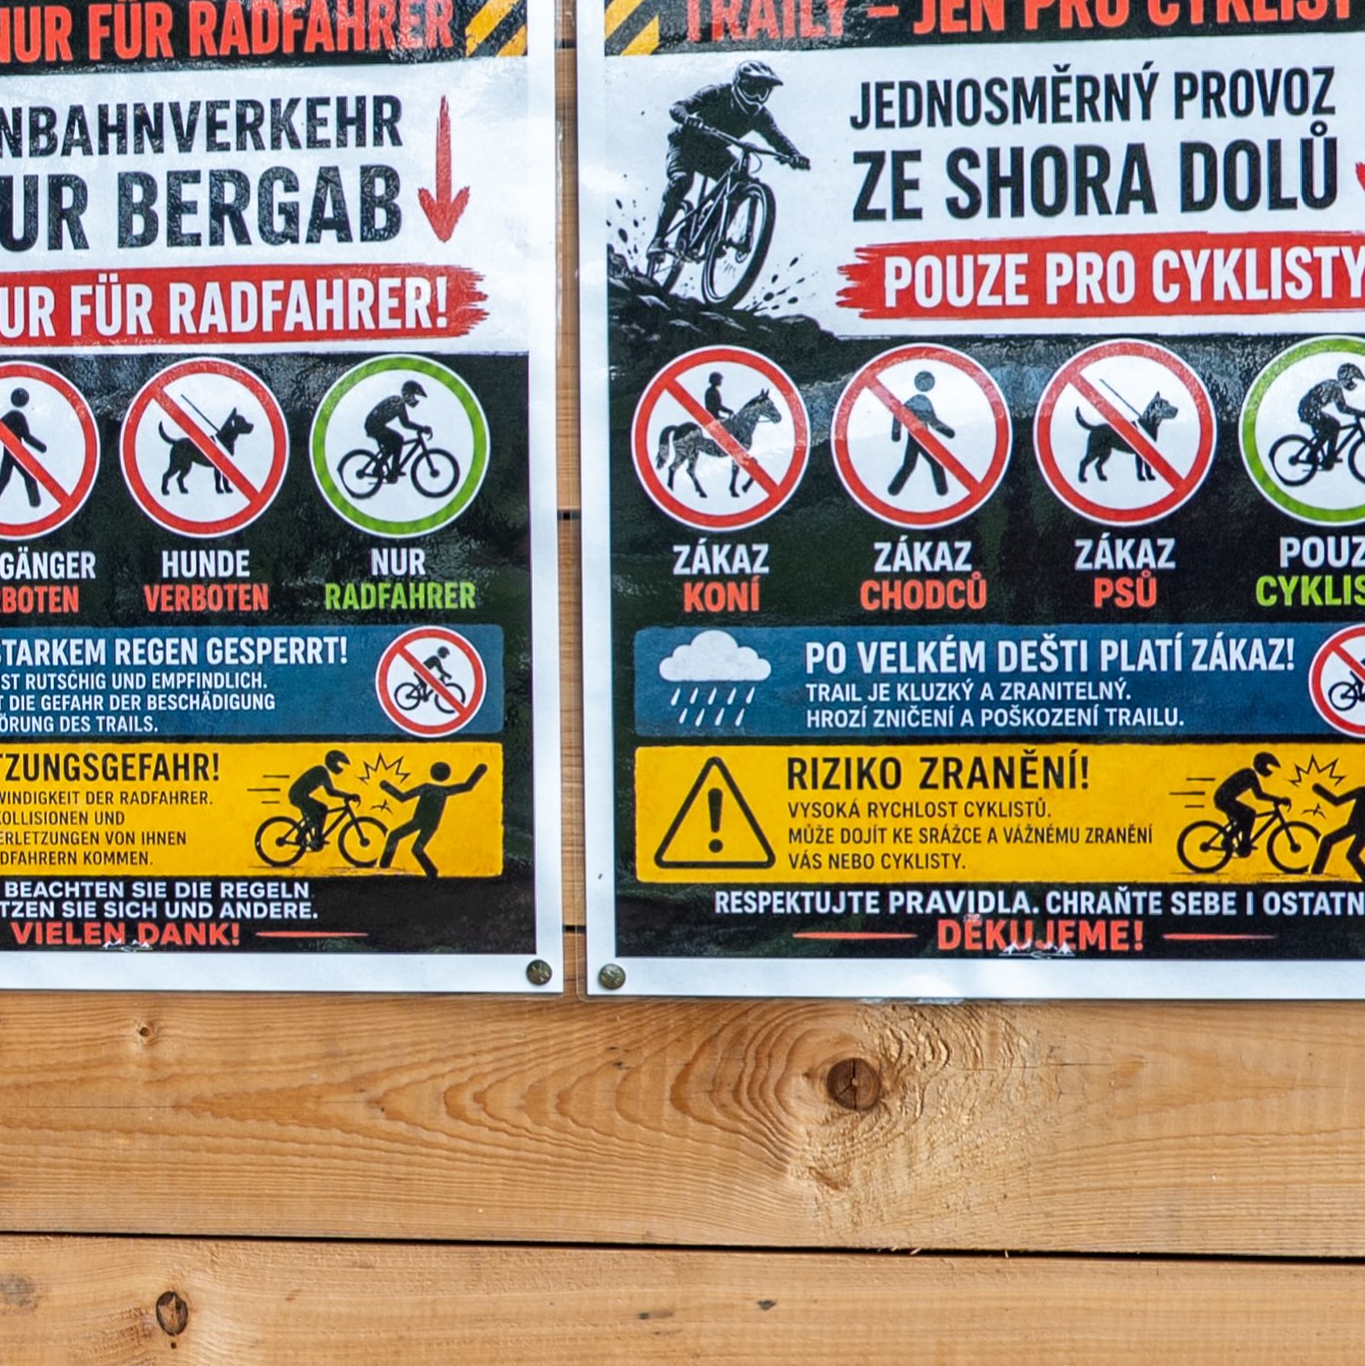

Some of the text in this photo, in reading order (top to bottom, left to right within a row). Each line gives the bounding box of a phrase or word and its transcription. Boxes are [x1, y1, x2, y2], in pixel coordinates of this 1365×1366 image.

[850, 61, 1335, 130] JEDNOSMĚRNÝ PROVOZ
[853, 121, 1337, 222] ZE SHORA DOLŮ
[117, 165, 401, 248] BERGAB
[885, 254, 1028, 307] POUZE
[1046, 251, 1135, 304] PRO
[71, 273, 153, 336] FÜR
[170, 276, 447, 333] RADFAHRER!
[162, 550, 250, 577] HUNDE
[372, 548, 425, 575] NUR
[673, 538, 769, 574] ZÁKAZ
[874, 535, 971, 572] ZÁKAZ
[1075, 533, 1175, 570] ZÁKAZ
[144, 584, 268, 611] VERBOTEN
[324, 581, 475, 610] RADFAHRER
[684, 575, 759, 612] KONÍ
[861, 571, 986, 610] CHODCŮ
[1095, 570, 1156, 608] PSŮ
[116, 638, 197, 665] REGEN
[207, 637, 347, 664] GESPERRT!
[806, 632, 1294, 673] PO VELKÉM DEŠTI PLATÍ ZÁKAZ!
[112, 673, 146, 689] UND
[152, 672, 267, 689] EMPFINDLICH.
[806, 677, 1131, 701] TRAIL JE KLUZKÝ A ZRANITELNÝ.
[10, 695, 35, 711] DIE
[41, 695, 103, 711] GEFAHR
[110, 695, 141, 710] DER
[148, 691, 275, 710] BESCHÄDIGUNG
[60, 716, 90, 732] DES
[96, 716, 158, 732] TRAILS.
[807, 704, 1184, 727] HROZÍ ZNIČENÍ A POŠKOZENÍ TRAILU.
[788, 749, 1088, 790] RIZIKO ZRANĚNÍ!
[86, 791, 113, 804] DER
[120, 791, 213, 805] RADFAHRER.
[788, 797, 1051, 818] VYSOKÁ RYCHLOST CYKLISTŮ.
[95, 811, 124, 825] UND
[105, 831, 135, 845] VON
[142, 831, 186, 845] IHNEN
[789, 824, 1152, 844] MŮŽE DOJÍT KE SRÁŽCE A VÁŽNÉMU ZRANĚNÍ
[84, 851, 153, 865] KOMMEN.
[789, 850, 965, 869] VÁS NEBO CYKLISTY.
[5, 882, 124, 897] BEACHTEN
[132, 882, 166, 898] SIE
[175, 882, 212, 898] DIE
[715, 886, 1364, 915] RESPEKTUJTE PRAVIDLA. CHRAŇTE SEBE I OSTATN
[62, 901, 96, 917] SIE
[104, 901, 157, 918] SICH
[165, 902, 213, 918] UND
[220, 902, 317, 918] ANDERE.
[11, 922, 239, 945] VIELEN DANK!
